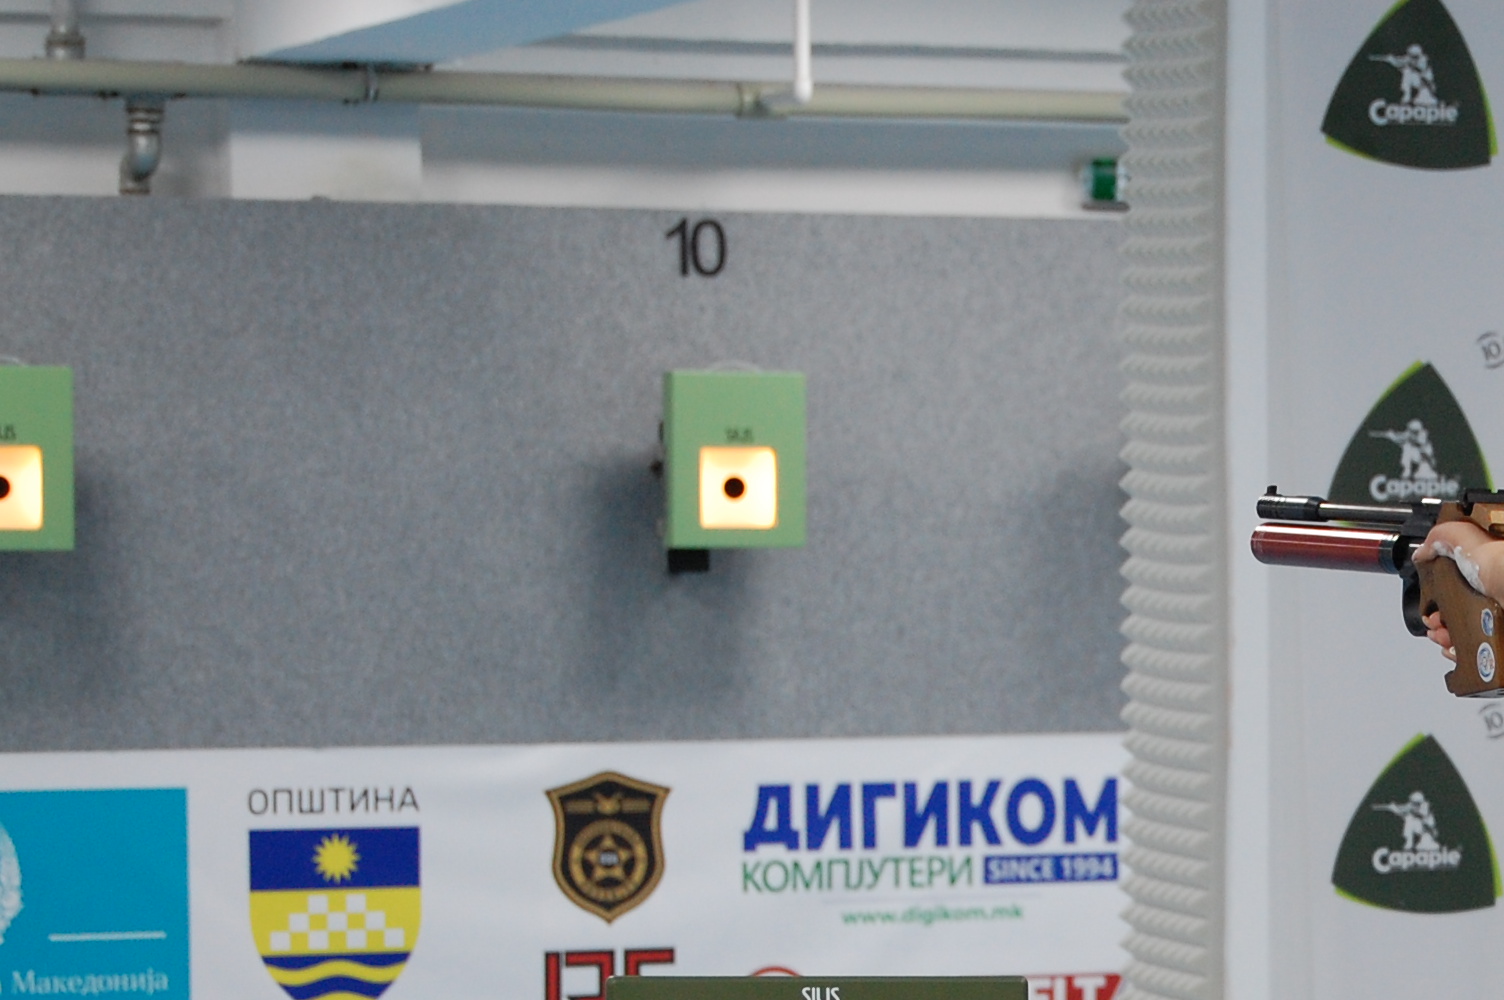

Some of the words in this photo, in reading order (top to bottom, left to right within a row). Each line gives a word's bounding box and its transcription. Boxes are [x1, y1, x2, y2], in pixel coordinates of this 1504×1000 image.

[666, 217, 727, 278] 10
[248, 786, 419, 816] ОПШТИНА
[743, 777, 1119, 853] ДИГИКОМ
[987, 858, 1054, 882] SINCE
[11, 967, 169, 997] Македонија
